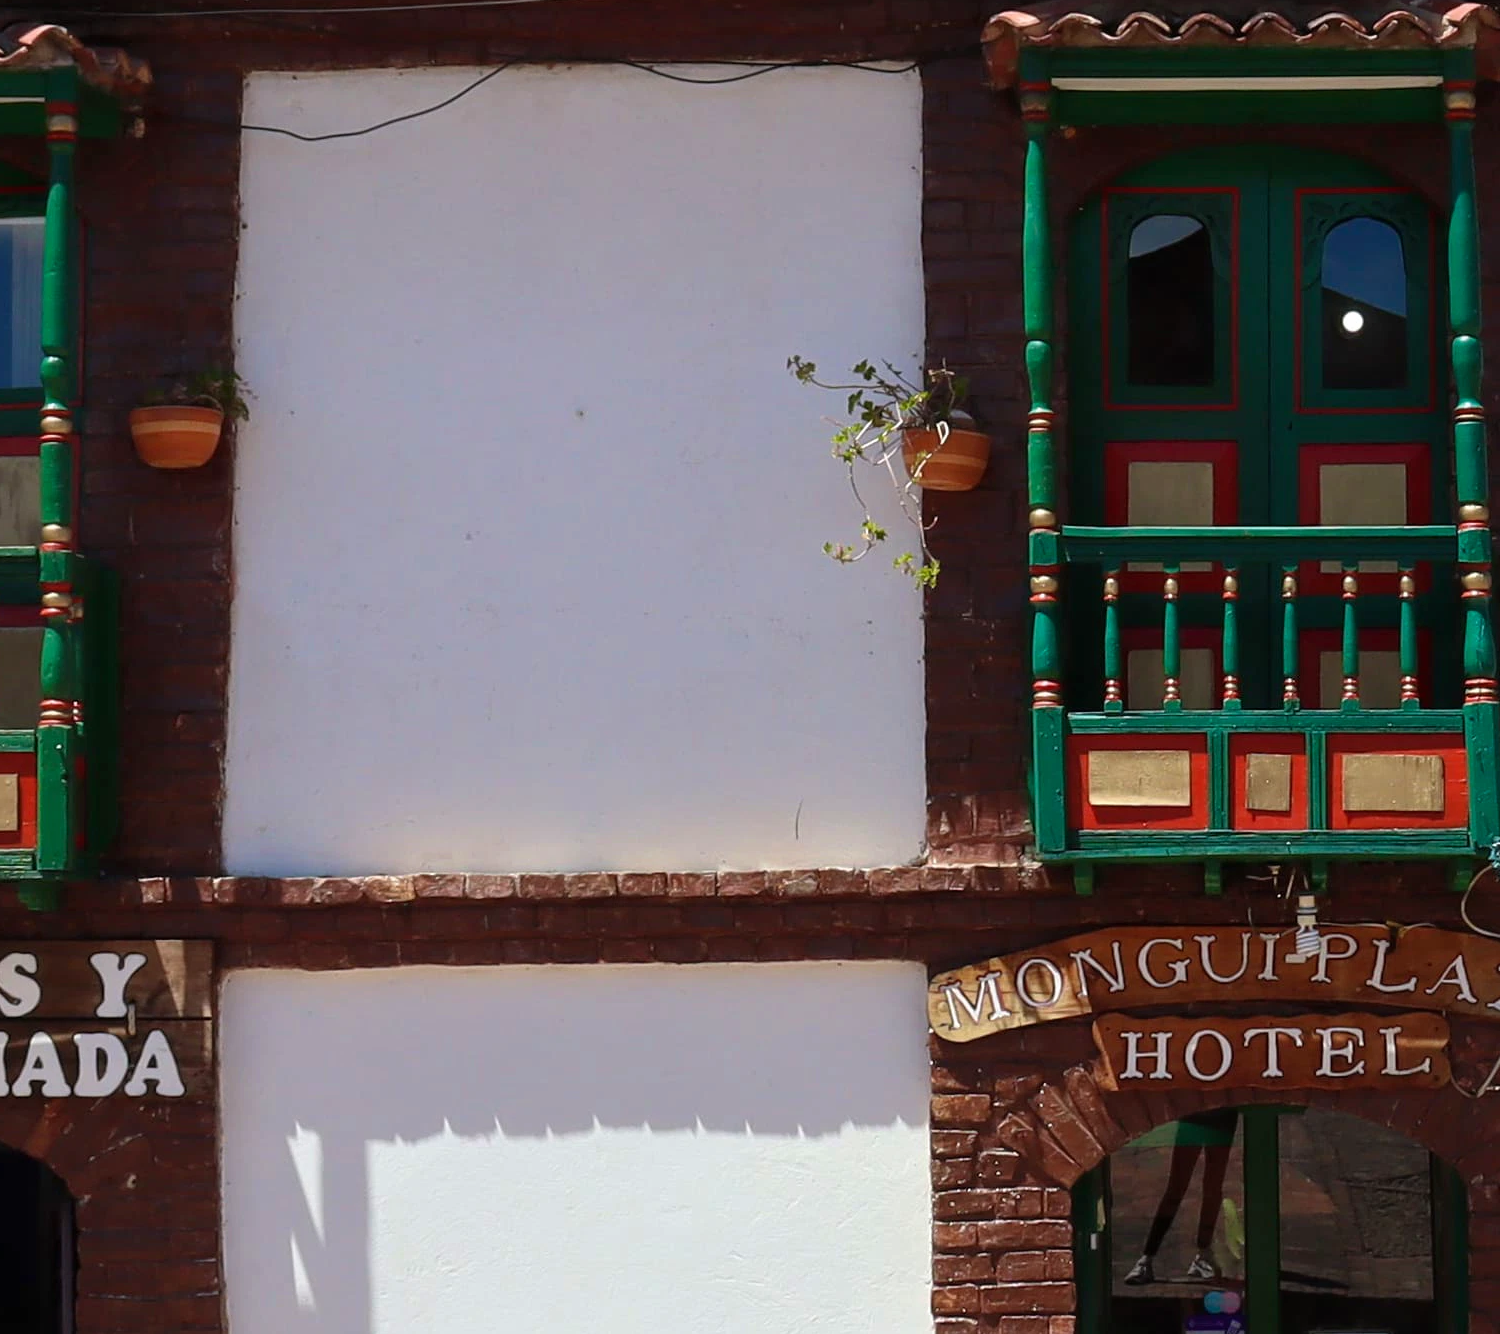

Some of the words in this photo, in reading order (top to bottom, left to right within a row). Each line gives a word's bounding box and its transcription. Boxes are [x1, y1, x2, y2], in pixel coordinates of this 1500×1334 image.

[90, 952, 146, 1017] Y
[938, 931, 1282, 1031] MONGUI
[1118, 1026, 1431, 1081] HOTEL
